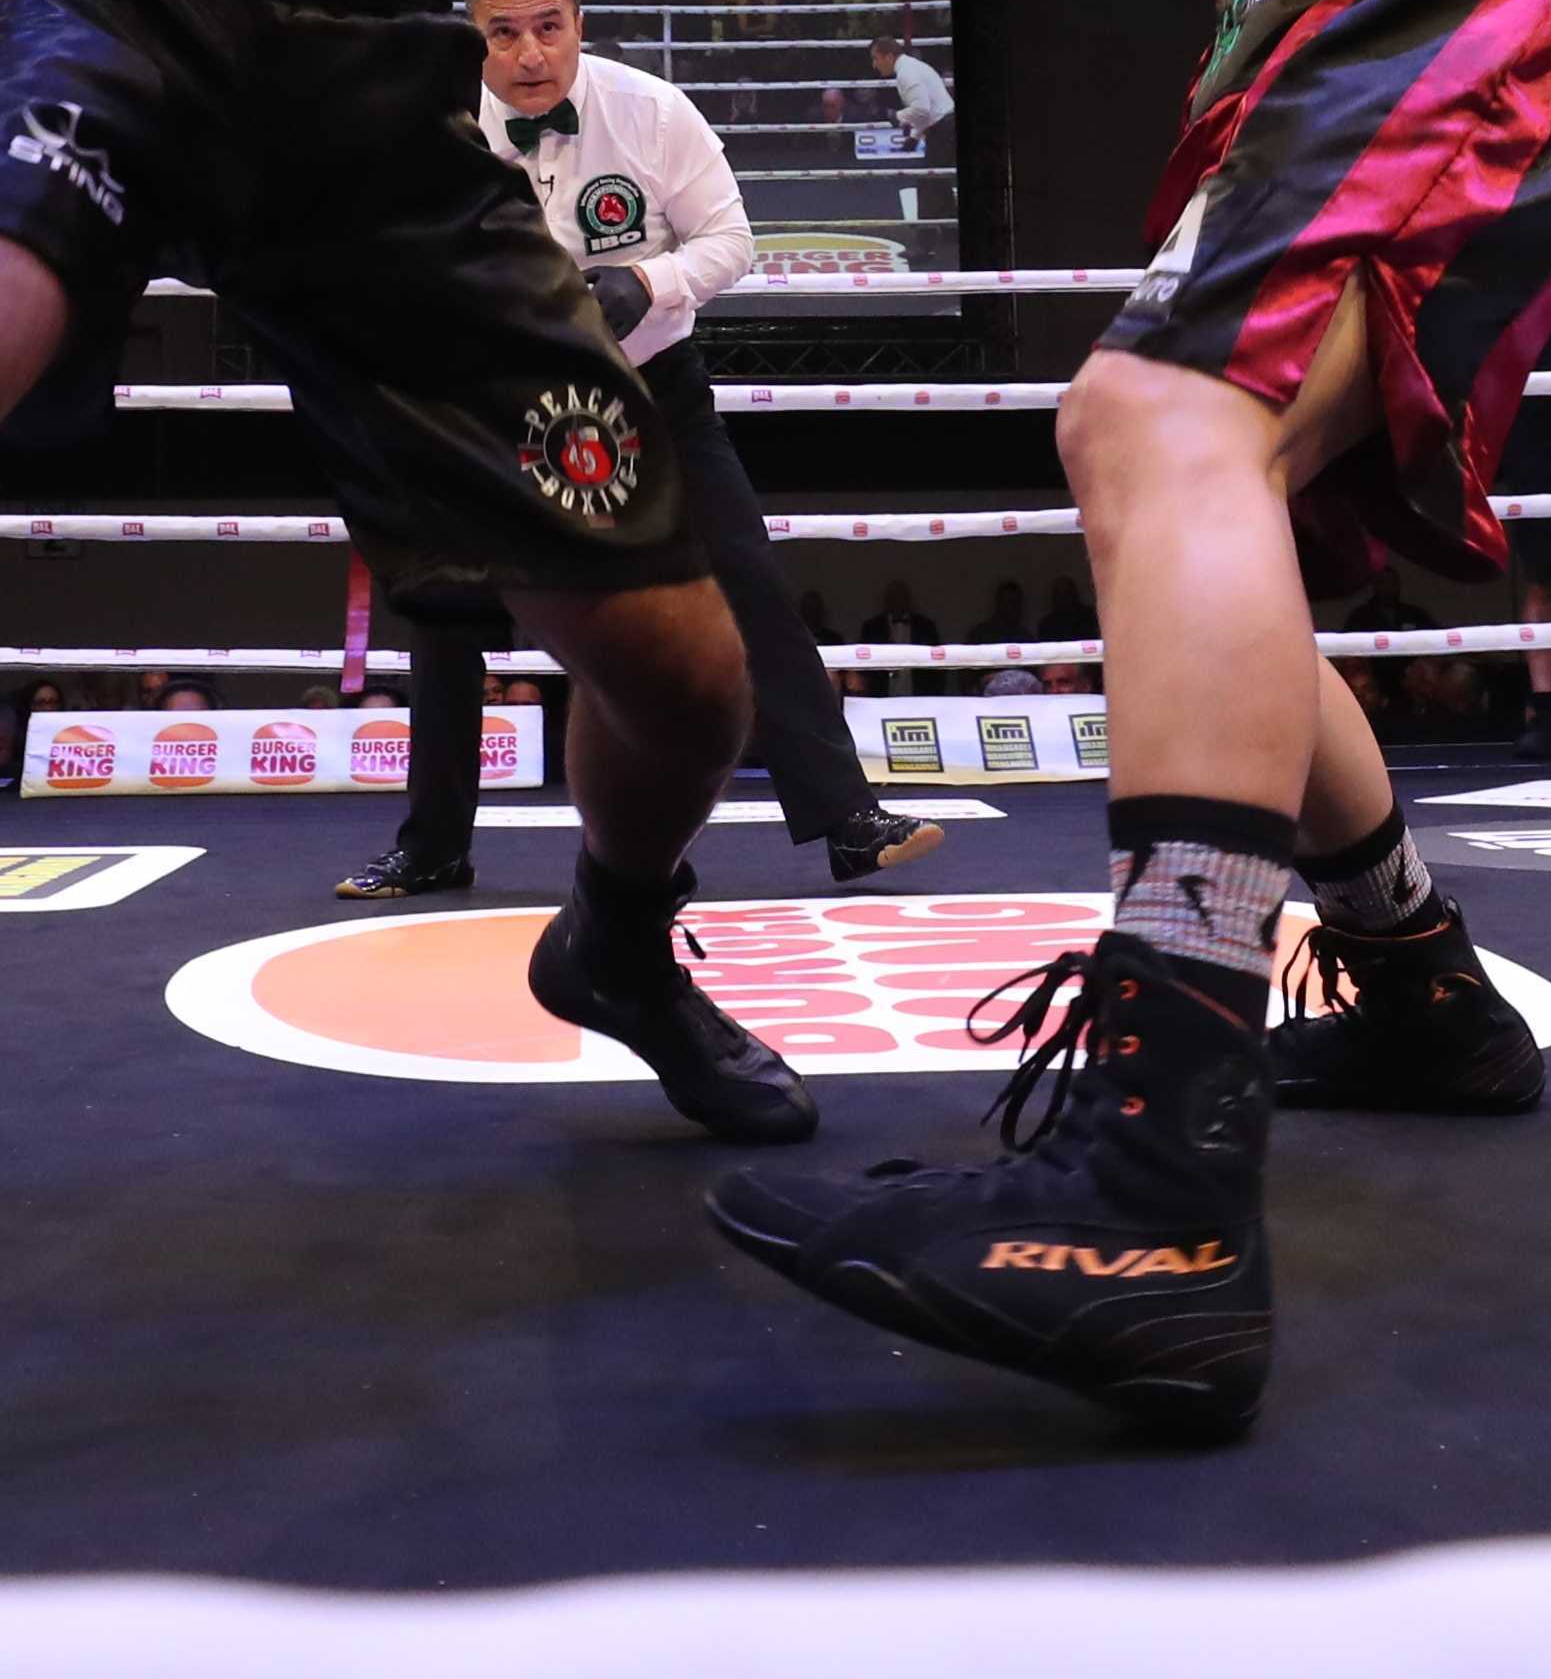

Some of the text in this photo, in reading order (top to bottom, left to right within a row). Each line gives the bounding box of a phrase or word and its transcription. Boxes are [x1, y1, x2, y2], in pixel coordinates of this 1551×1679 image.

[8, 134, 124, 226] STING
[590, 230, 642, 252] IBO
[524, 384, 629, 434] PEACH
[540, 465, 638, 515] BOXING
[50, 744, 116, 758] BURGER
[152, 743, 218, 756] BURGER
[251, 740, 317, 755] BURGER
[351, 740, 411, 754] BURGE
[48, 758, 115, 778] KING
[149, 757, 216, 775] KING
[250, 754, 316, 773] KING
[981, 1240, 1238, 1278] RIVAL
